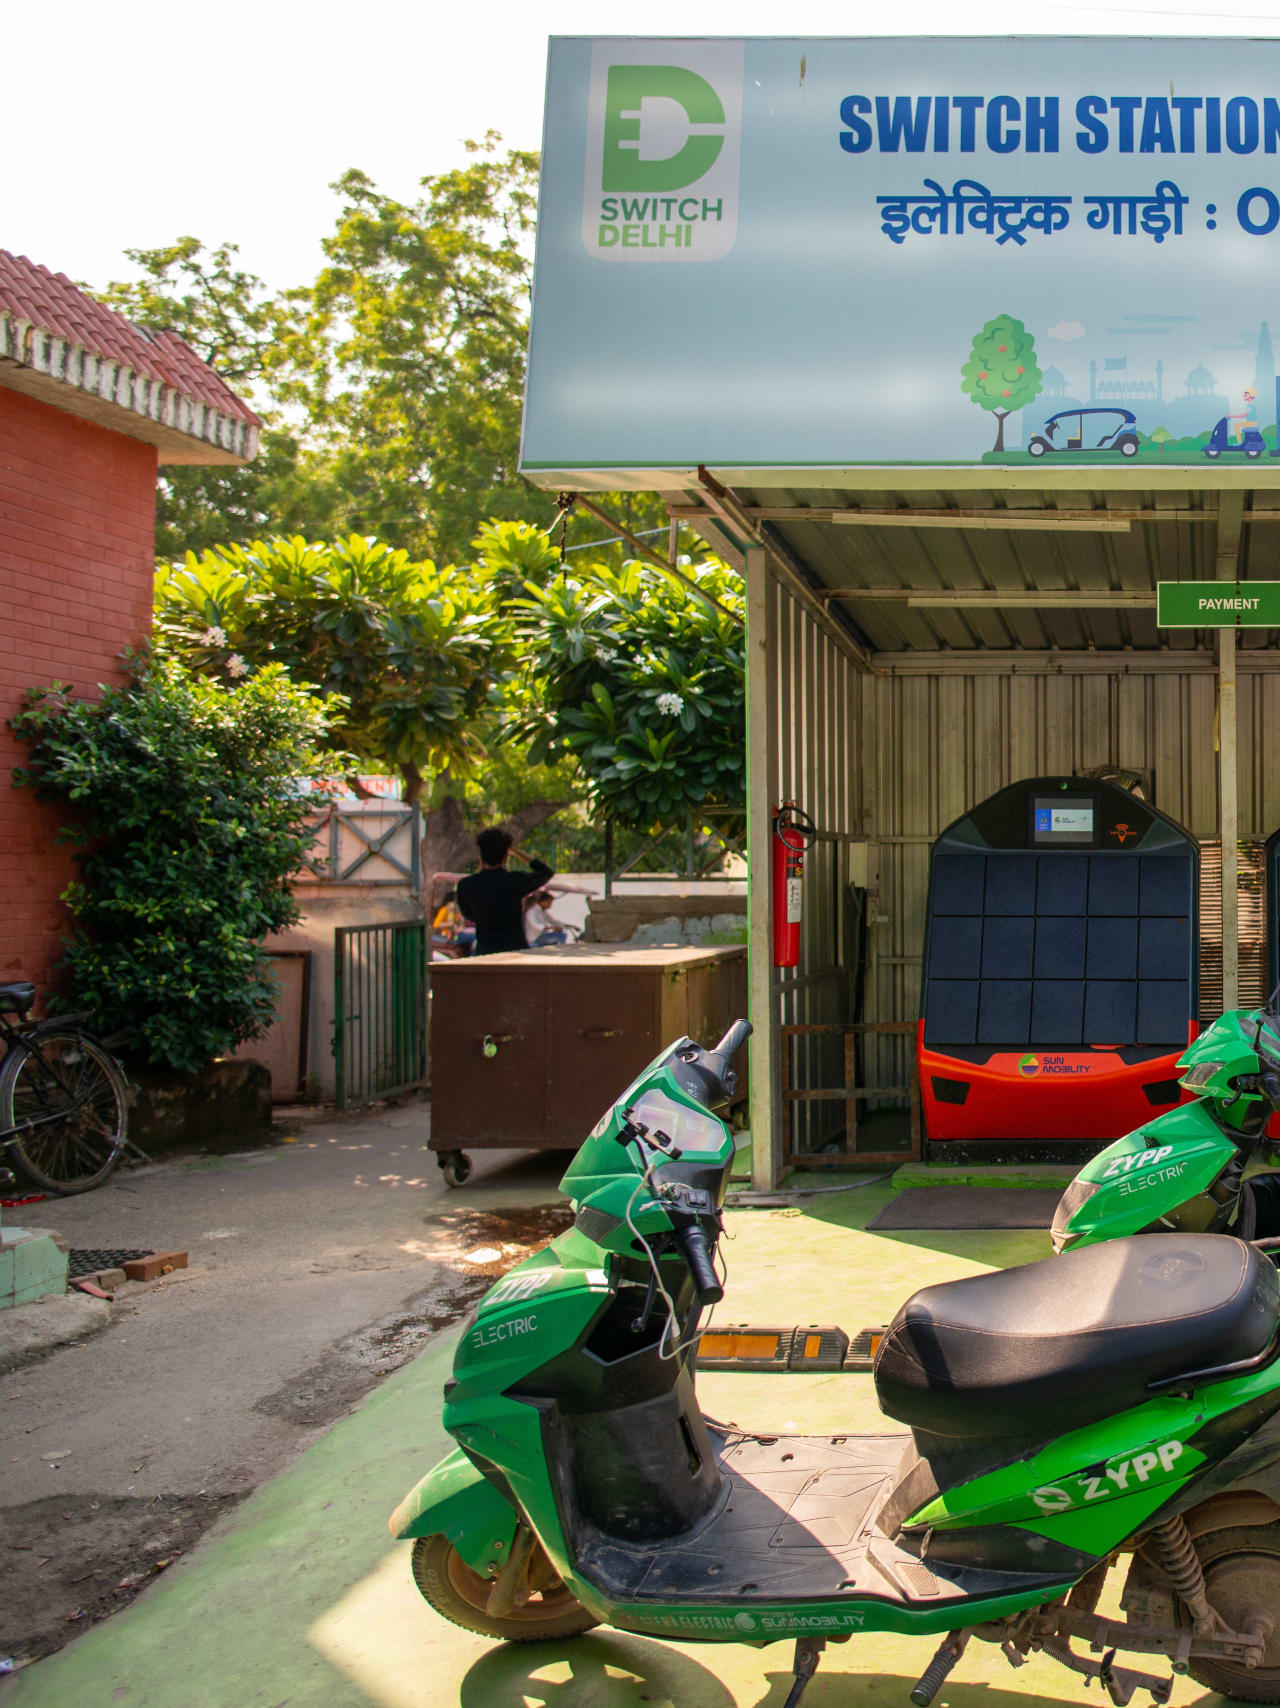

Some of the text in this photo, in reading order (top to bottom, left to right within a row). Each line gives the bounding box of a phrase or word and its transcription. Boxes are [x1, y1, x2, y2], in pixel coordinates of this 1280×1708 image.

[839, 94, 1059, 154] SWITCH
[600, 198, 723, 221] SWITCH
[876, 178, 1072, 246] इलेक्ट्रिक
[1084, 180, 1189, 243] गाड़ी
[598, 224, 692, 247] DELHI
[1198, 598, 1260, 610] PAYMENT
[1043, 1056, 1064, 1065] SUN
[1043, 1065, 1090, 1073] MOBILITY
[1103, 1145, 1173, 1177] ZYPP
[482, 1273, 553, 1307] ZYPP
[472, 1315, 538, 1349] ELECTRIC
[1078, 1440, 1184, 1501] ZYPP
[761, 1616, 865, 1628] SUNMOBILITY
